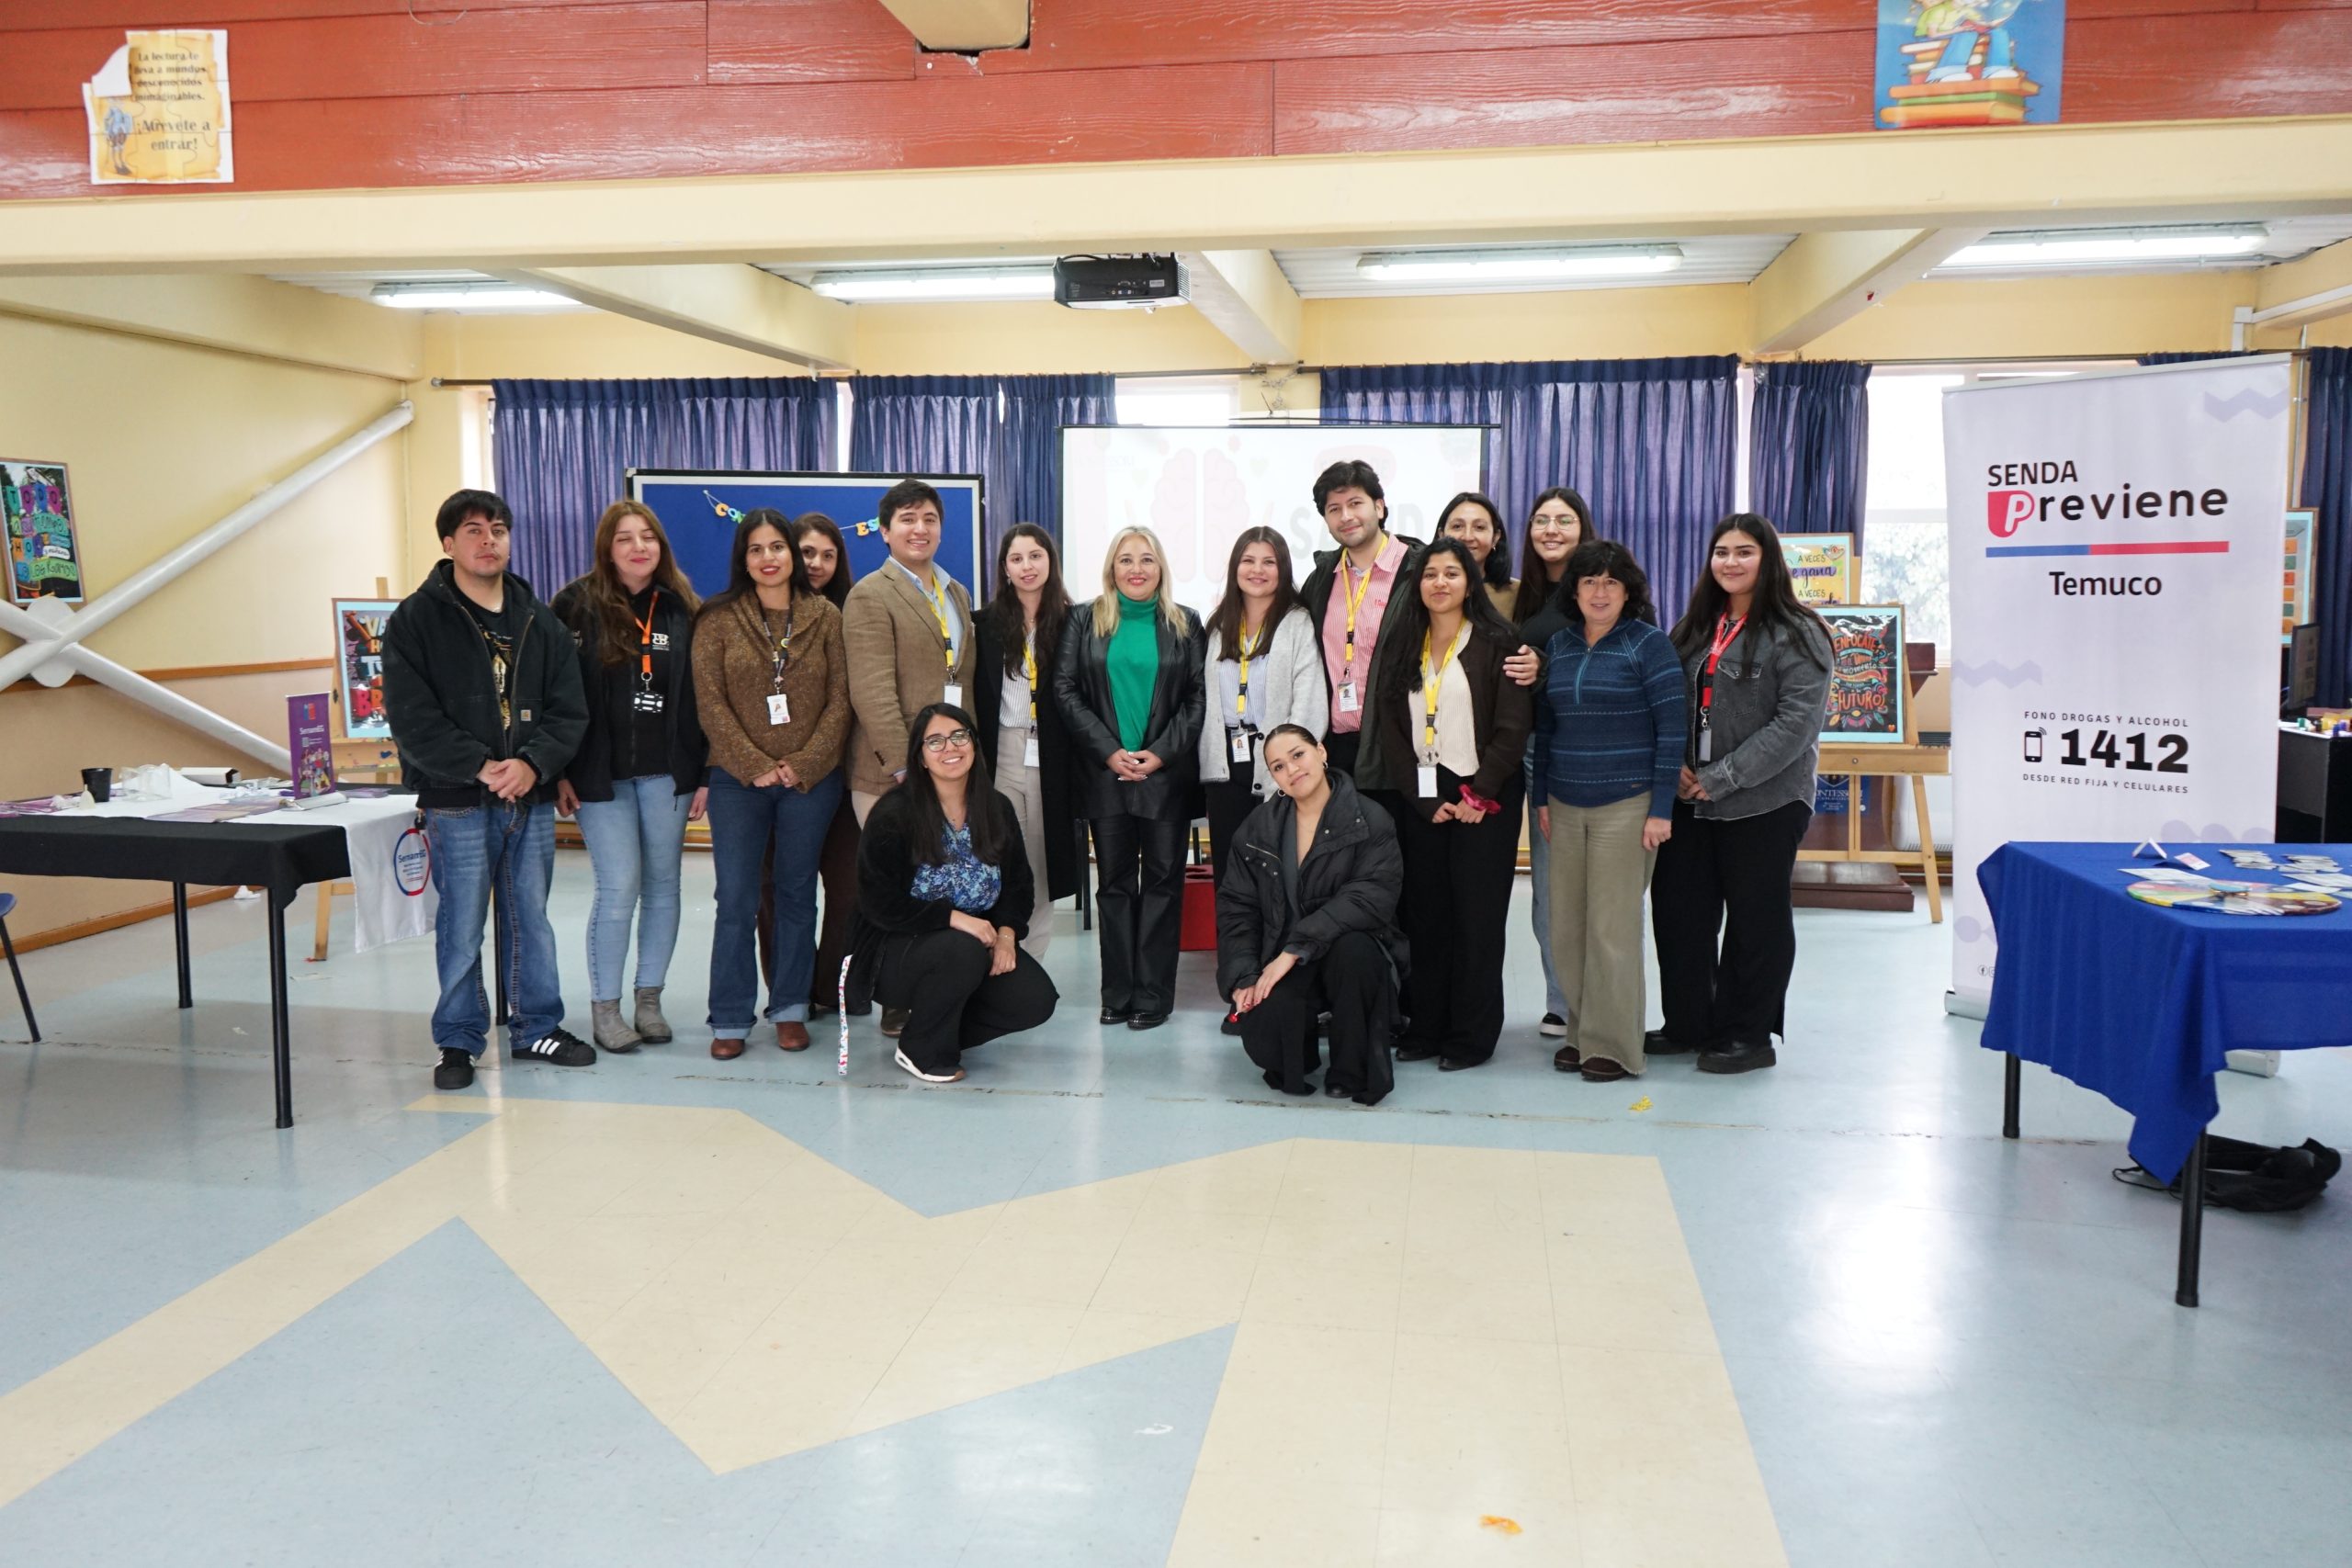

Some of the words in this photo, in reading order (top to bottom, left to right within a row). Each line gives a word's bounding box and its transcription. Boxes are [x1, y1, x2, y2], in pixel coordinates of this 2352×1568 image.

[152, 52, 186, 62] lectura
[166, 64, 206, 73] mundos
[202, 123, 209, 131] a
[151, 138, 198, 151] entrar!
[1988, 460, 2078, 487] SENDA
[1988, 483, 2228, 537] Previene
[1805, 554, 1826, 563] VECES
[1801, 566, 1837, 589] gana
[2049, 571, 2162, 596] Temuco
[1798, 590, 1804, 598] A
[1805, 589, 1826, 598] VECES
[2024, 711, 2056, 721] FONO
[2062, 713, 2110, 723] DROGAS
[2117, 716, 2122, 724] Y
[2129, 716, 2188, 728] ALCOHOL
[2061, 728, 2188, 773] 1412
[2022, 773, 2056, 783] DESDE
[2061, 776, 2080, 785] RED
[2086, 778, 2109, 787] FIJA
[2124, 782, 2188, 794] CELULARES
